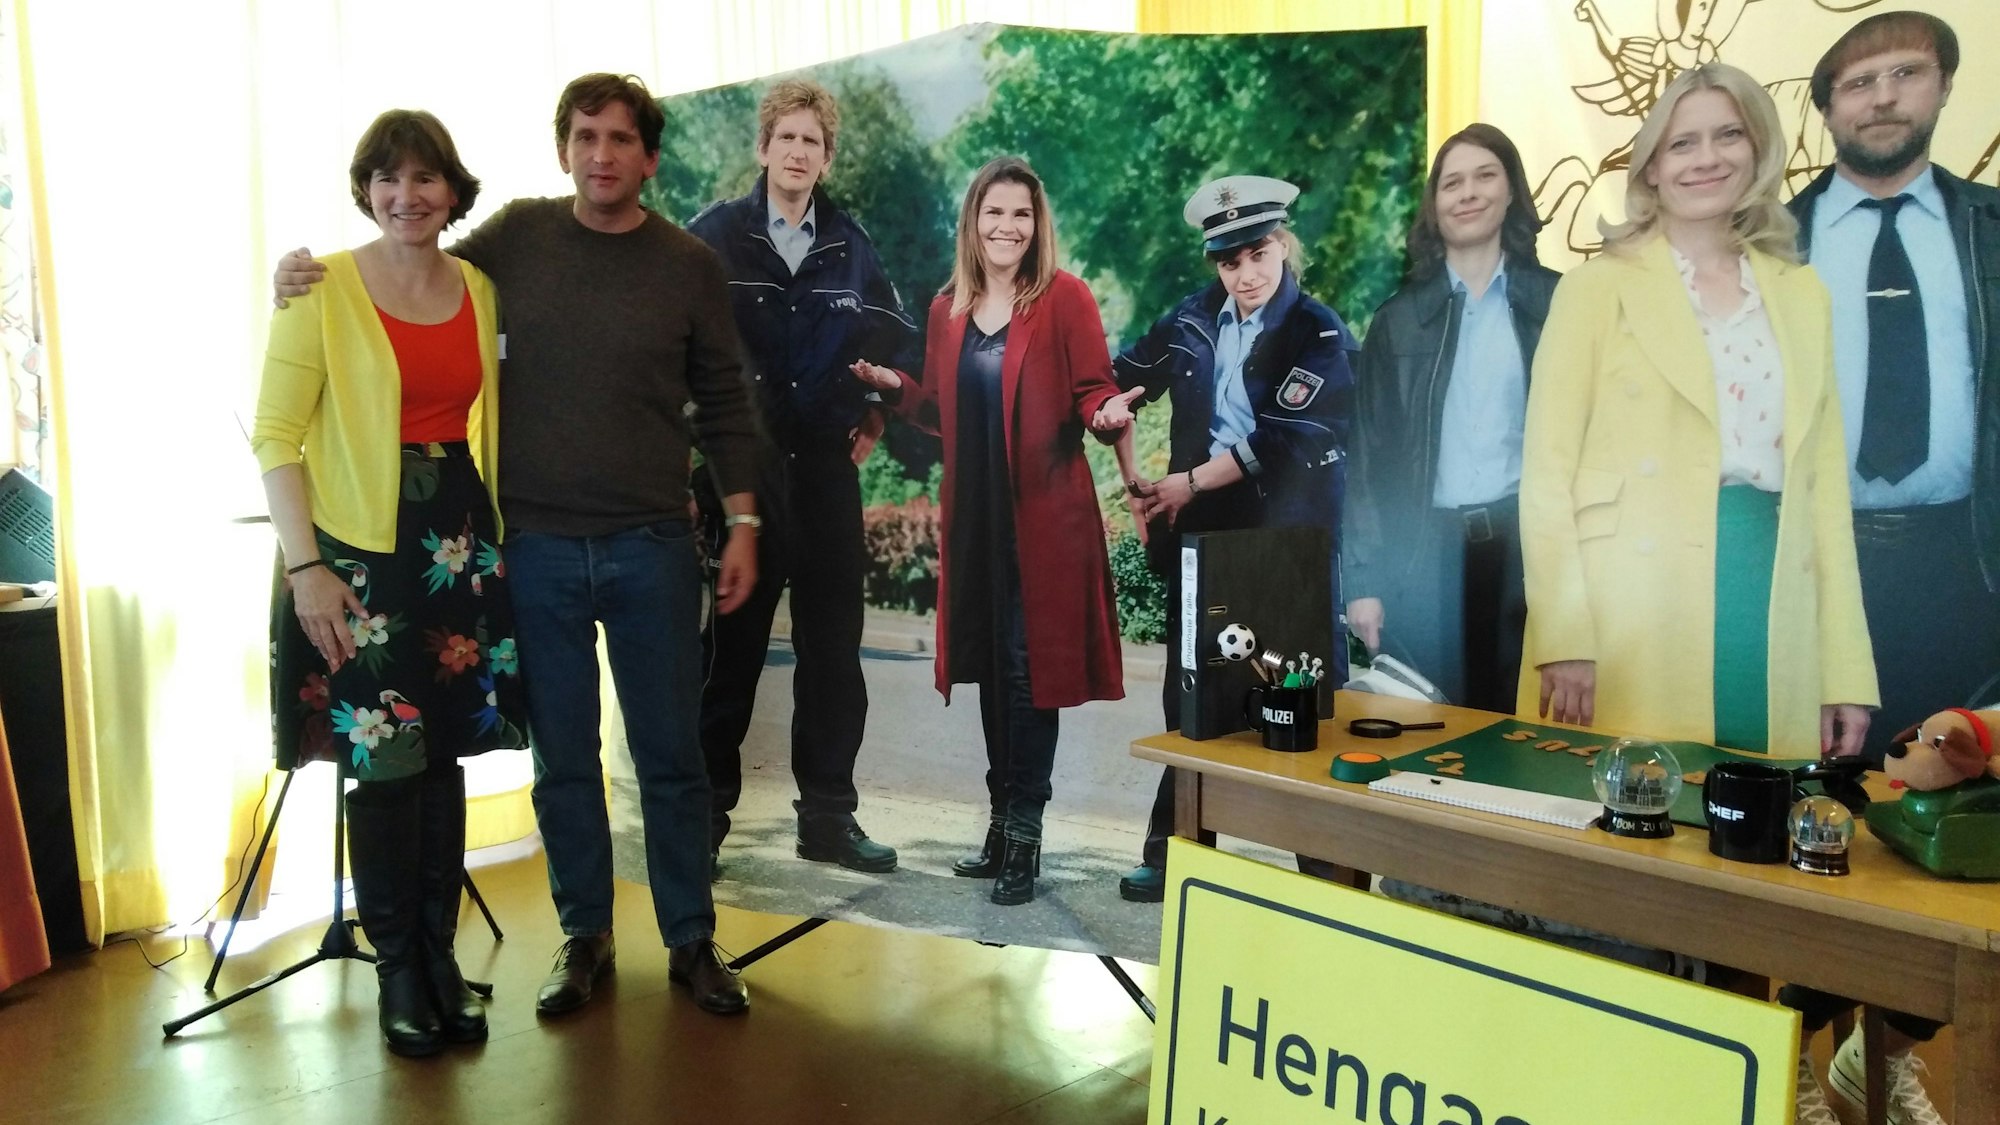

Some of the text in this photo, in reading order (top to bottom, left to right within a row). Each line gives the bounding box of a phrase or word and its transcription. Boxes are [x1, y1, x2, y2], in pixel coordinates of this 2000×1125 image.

[1292, 371, 1321, 387] POLIZEI
[1262, 706, 1294, 725] POLIZEI
[1708, 800, 1746, 821] CHEF
[1615, 817, 1635, 831] DOM
[1217, 984, 1532, 1125] Henga
